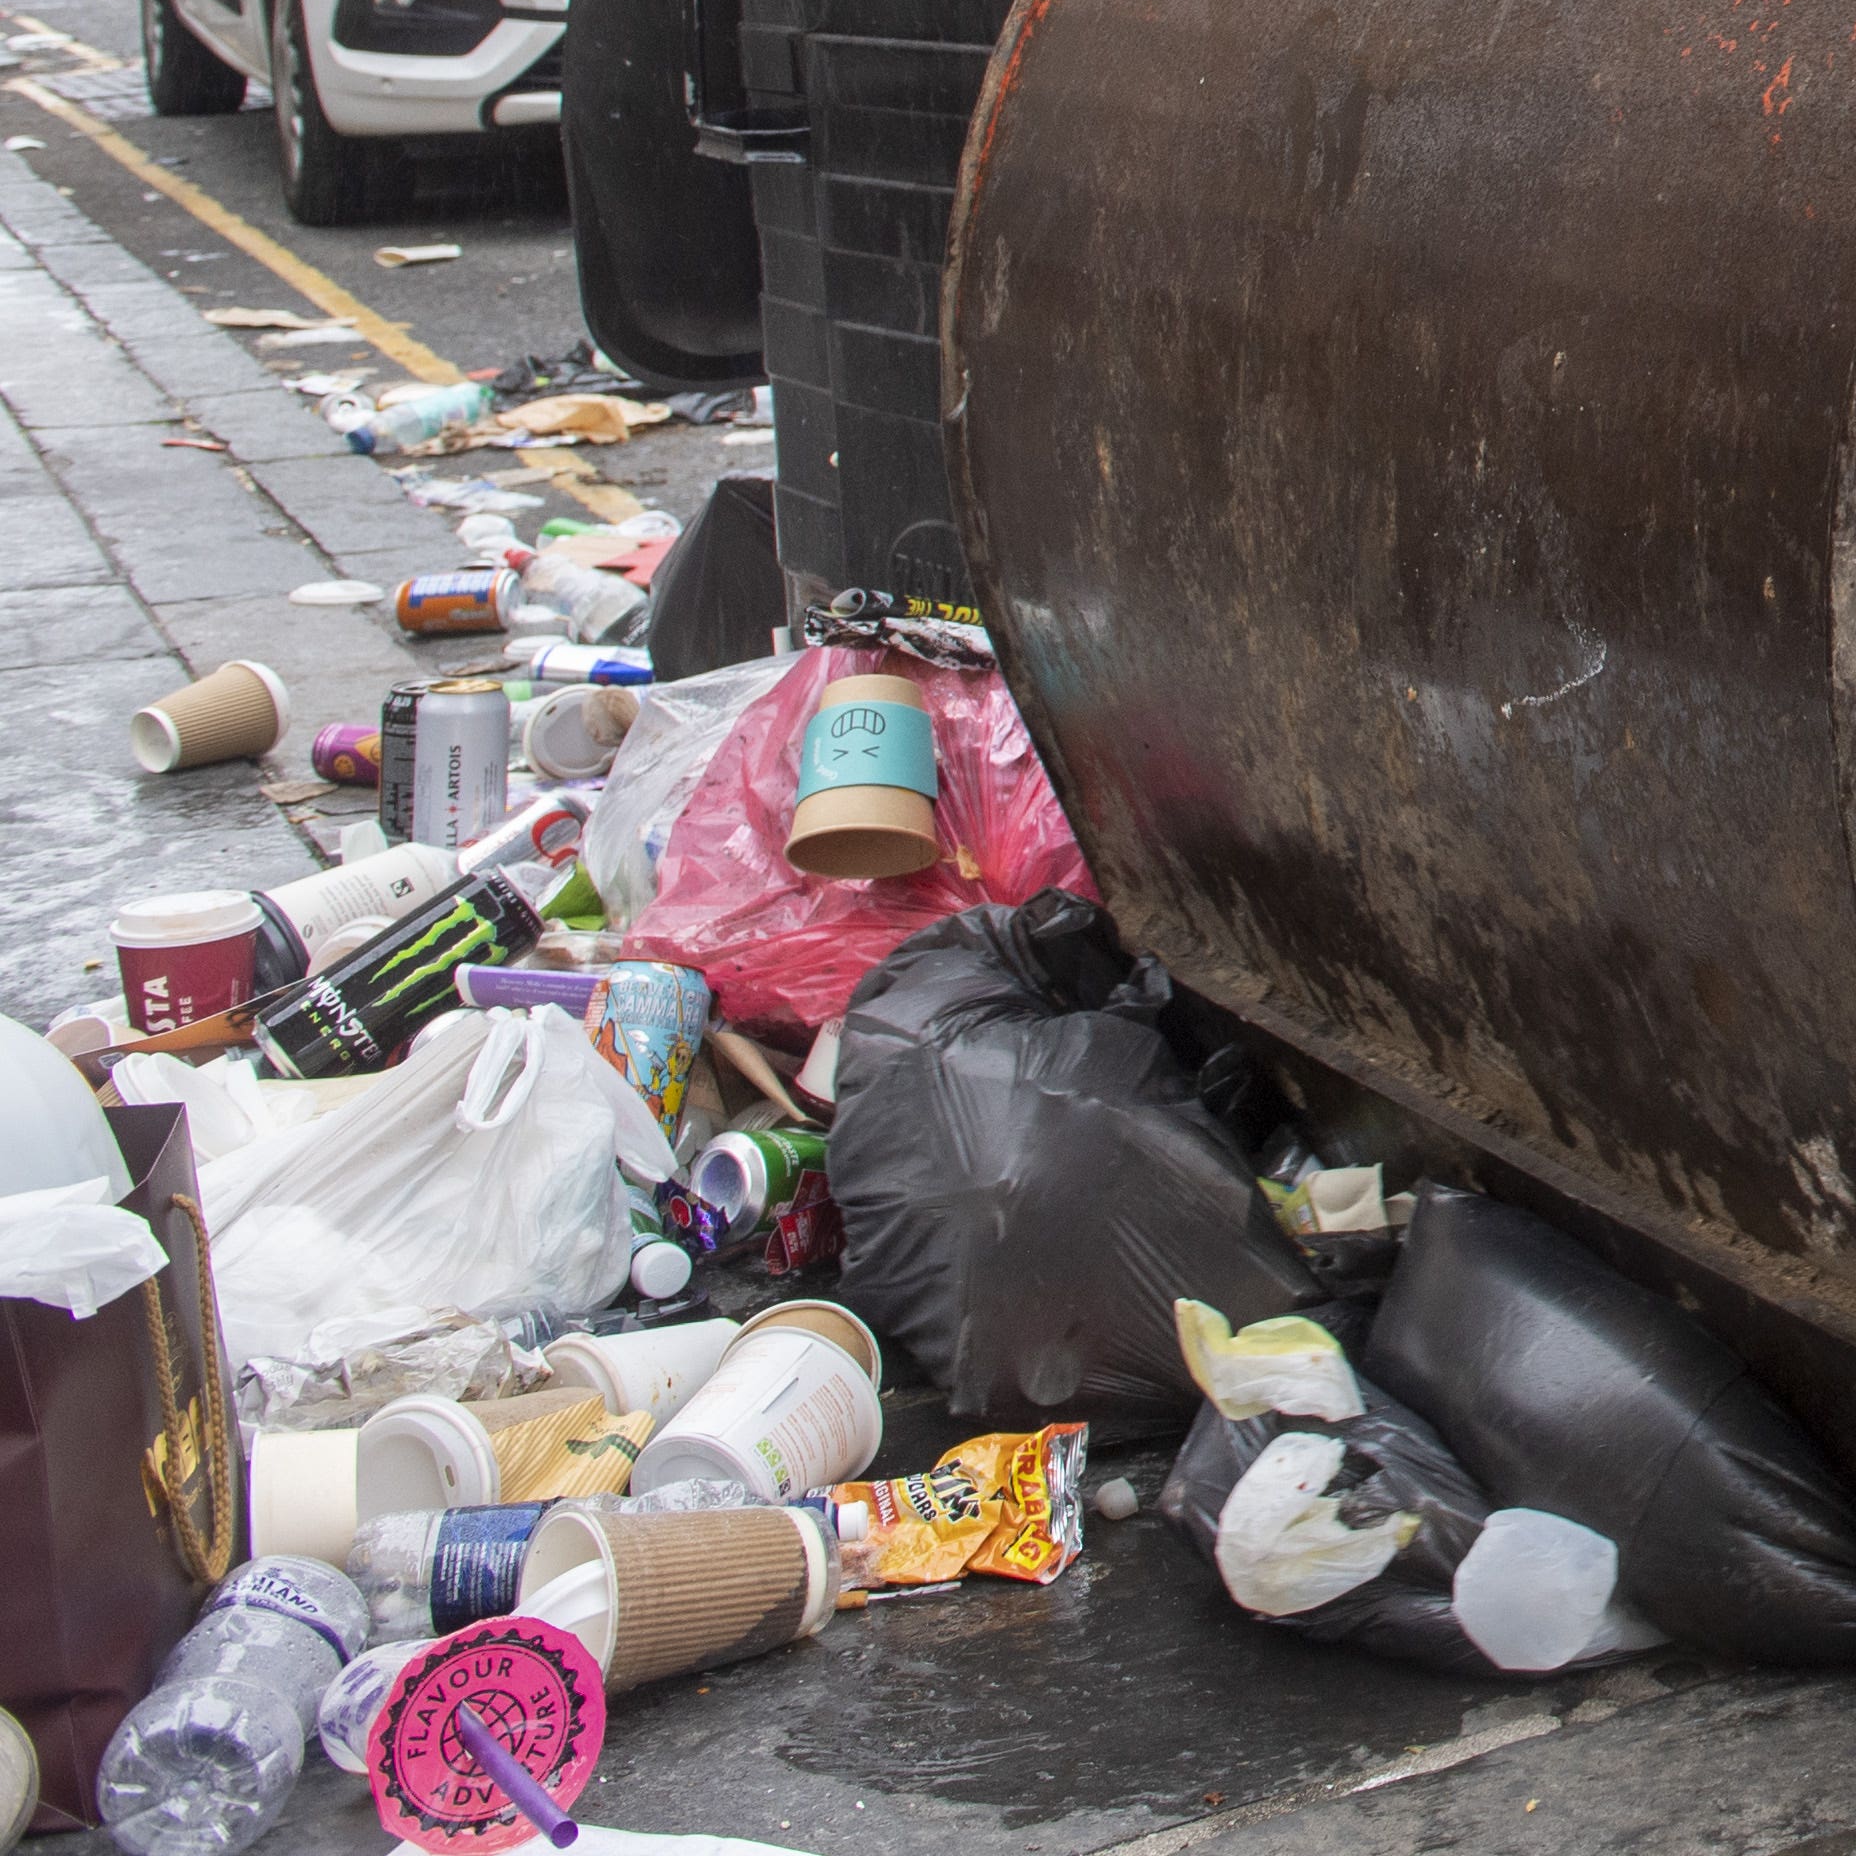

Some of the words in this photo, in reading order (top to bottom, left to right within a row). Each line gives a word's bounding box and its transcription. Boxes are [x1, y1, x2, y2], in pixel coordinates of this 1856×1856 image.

[447, 744, 462, 801] ARTOIS
[178, 995, 195, 1025] FEE
[615, 996, 676, 1018] GAMMA
[407, 1657, 514, 1760] FLAVOUR
[431, 1685, 559, 1808] ADVTURE
